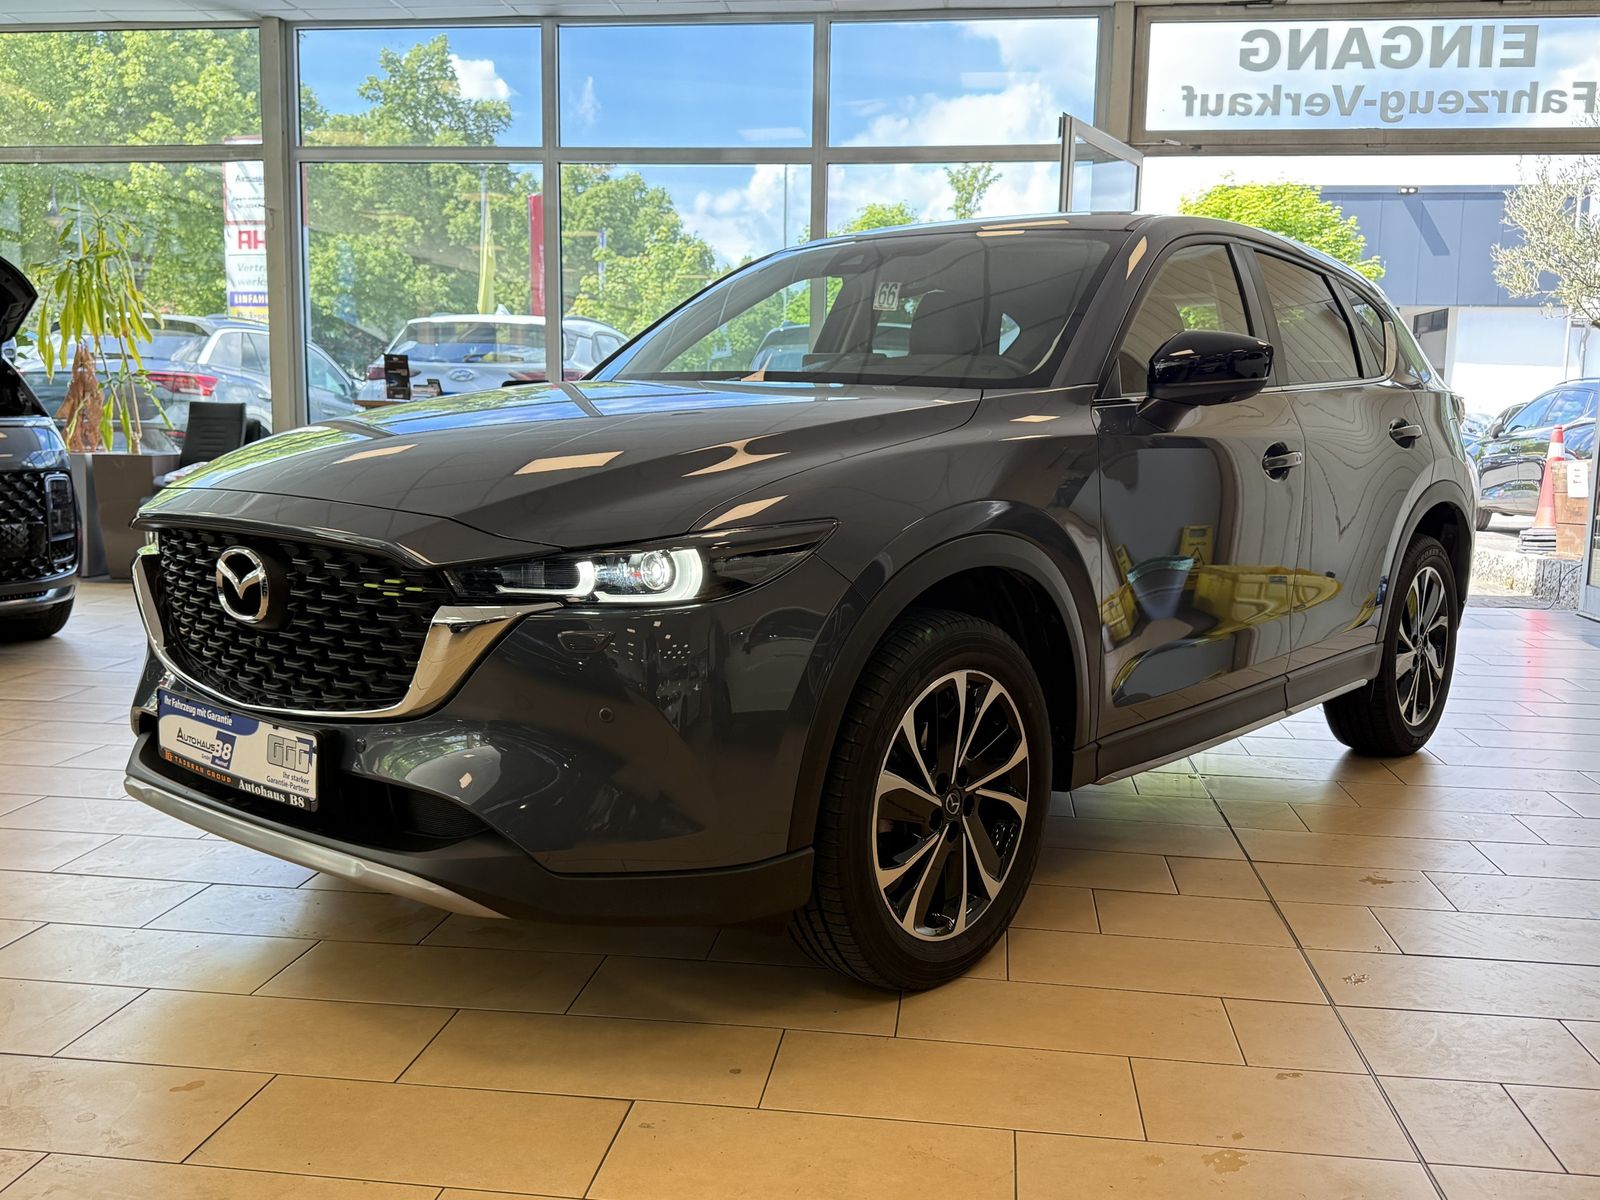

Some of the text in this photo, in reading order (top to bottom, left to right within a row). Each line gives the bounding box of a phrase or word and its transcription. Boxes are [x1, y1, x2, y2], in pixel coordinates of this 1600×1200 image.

[171, 698, 197, 717] Fahrzeug
[197, 707, 207, 718] mit
[207, 709, 233, 727] Garantie
[238, 778, 305, 808] Autohaus B8
